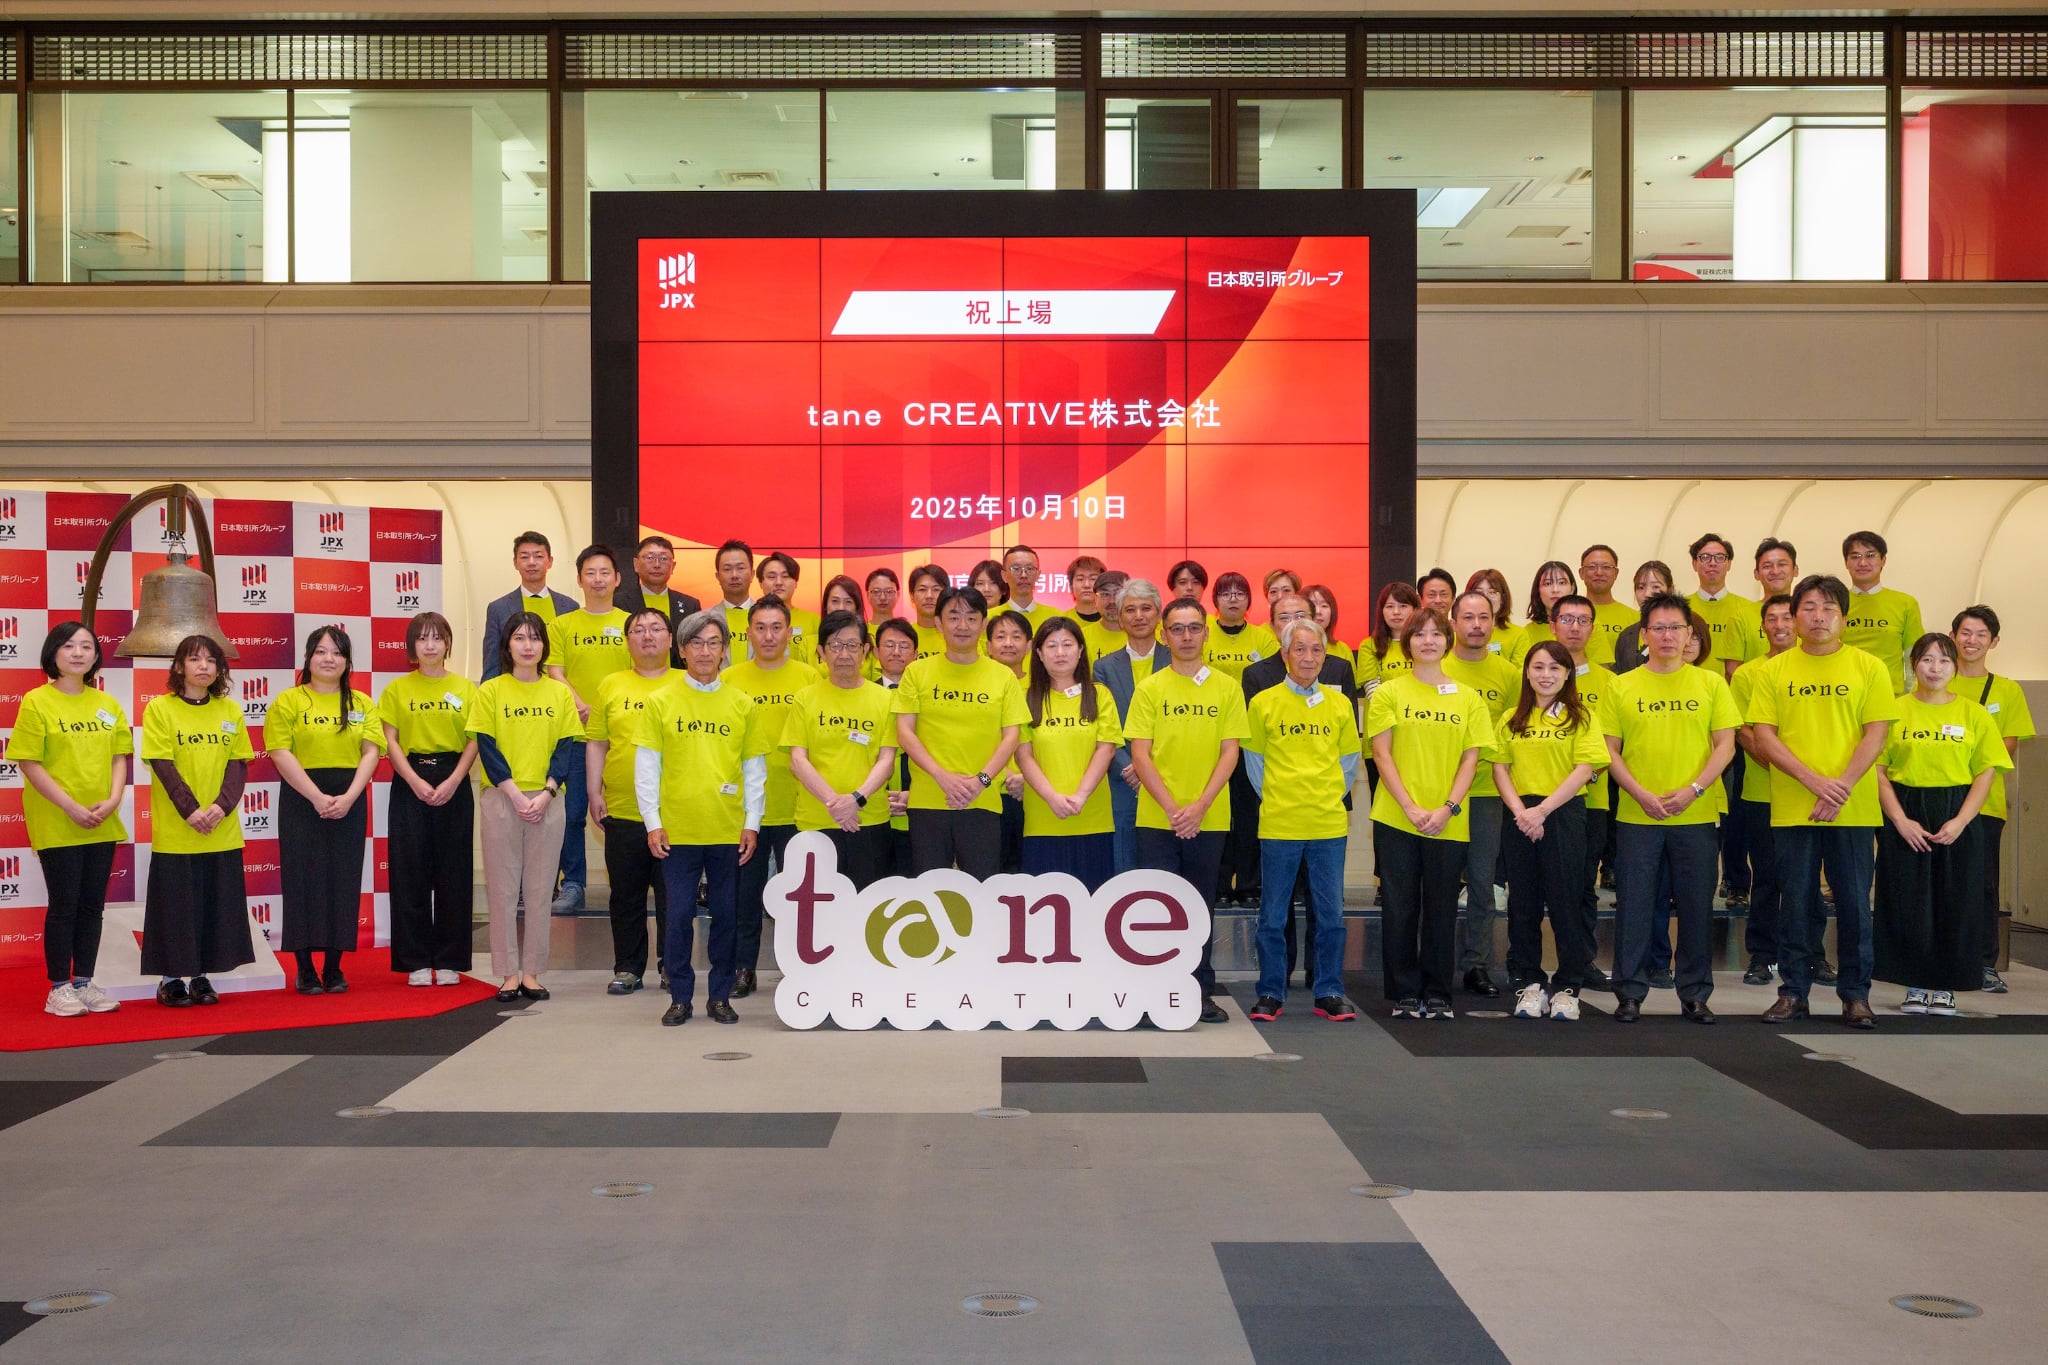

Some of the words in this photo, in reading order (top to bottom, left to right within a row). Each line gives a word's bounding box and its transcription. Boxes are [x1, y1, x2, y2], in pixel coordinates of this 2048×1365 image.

[1207, 270, 1343, 288] 日本取引所グループ
[659, 293, 695, 309] JPX
[965, 299, 1052, 325] 祝上場
[807, 405, 882, 427] tane
[903, 398, 1221, 429] CREATIVE株式会社
[910, 494, 1126, 521] 2025年10月10日
[54, 517, 111, 526] 日本取引所グル
[220, 523, 286, 533] 日本取引所グループ
[0, 525, 16, 535] PX
[376, 531, 437, 541] 日本取引所グループ
[320, 537, 344, 547] JPX
[300, 582, 363, 593] 日本取引所グループ
[243, 590, 267, 600] JPX
[396, 596, 419, 605] JPX
[1846, 617, 1889, 628] ane
[574, 631, 623, 646] tane
[0, 644, 17, 654] PX
[1379, 660, 1413, 671] tan
[933, 684, 990, 704] tane
[1788, 681, 1849, 697] tane
[753, 693, 795, 705] ane
[1637, 697, 1699, 713] tane
[243, 703, 267, 713] JPX
[504, 703, 555, 718] tane
[1163, 699, 1219, 718] tane
[1404, 704, 1461, 725] tane
[676, 715, 731, 737] tane
[818, 710, 874, 732] tane
[1045, 717, 1090, 727] ane
[175, 729, 231, 746] tane
[0, 764, 17, 774] PX
[245, 817, 268, 826] JPX
[1, 884, 19, 894] PX
[785, 851, 1189, 968] tane
[796, 991, 1180, 1009] CREATIVE
